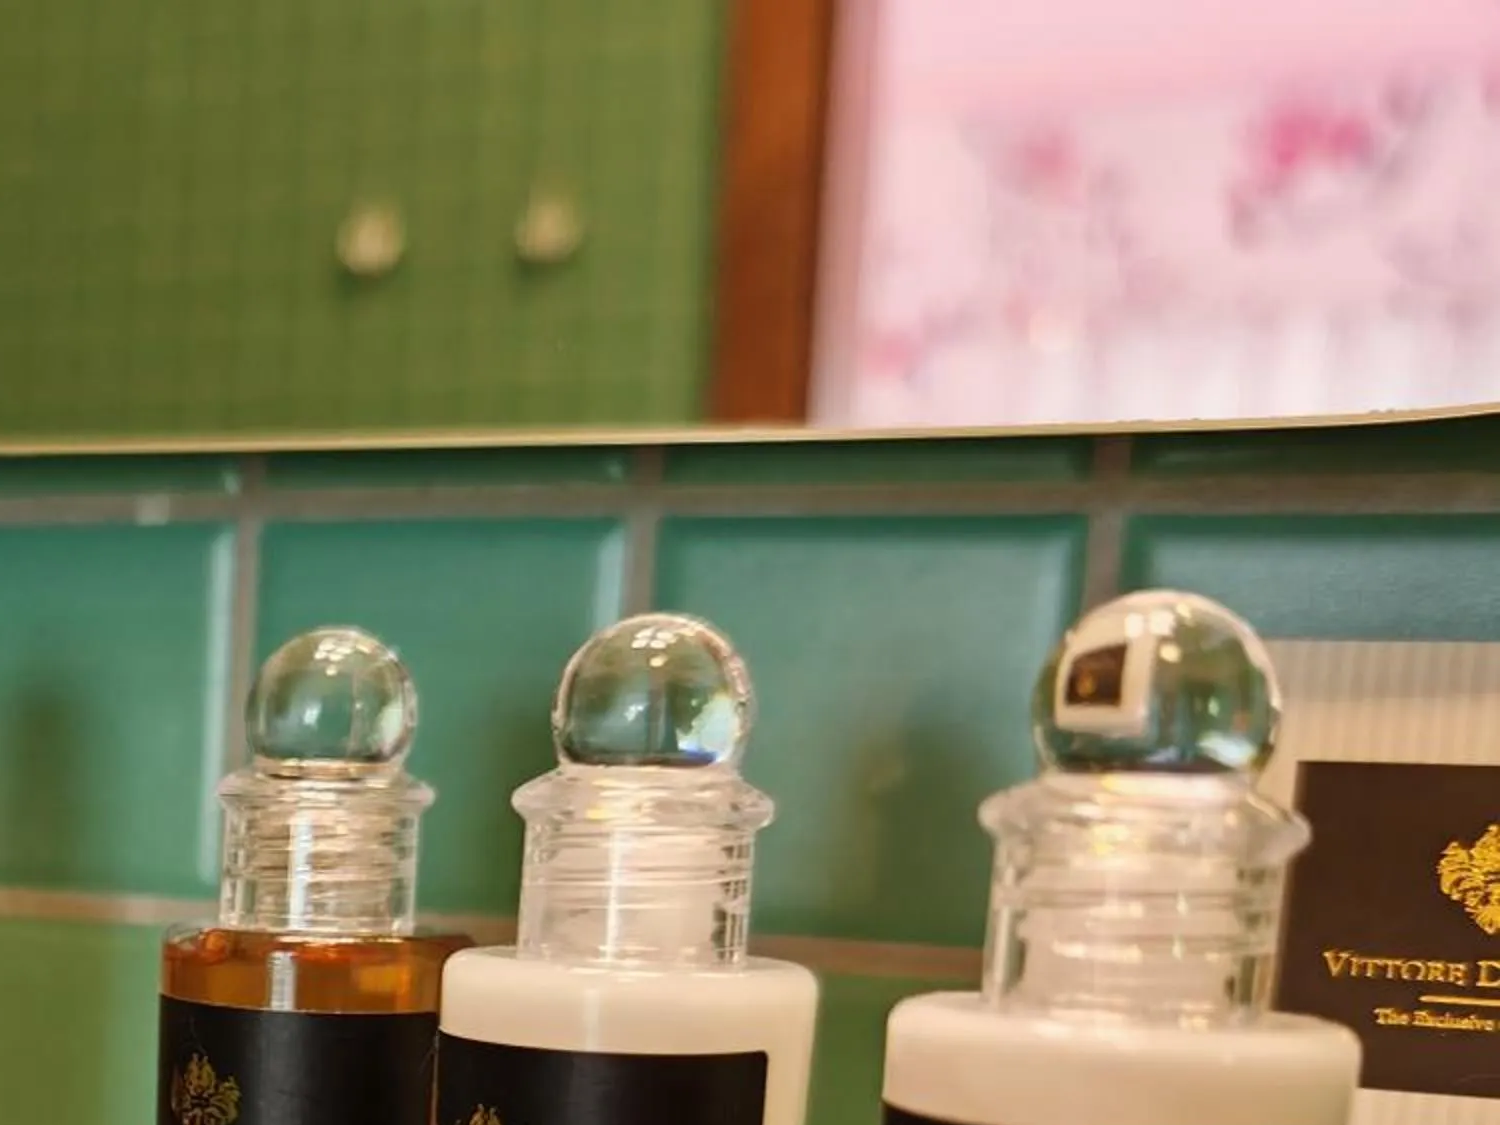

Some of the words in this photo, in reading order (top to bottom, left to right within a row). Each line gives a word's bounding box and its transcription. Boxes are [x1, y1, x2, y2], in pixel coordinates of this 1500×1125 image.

[1321, 951, 1467, 986] VITTORE
[1475, 960, 1500, 988] D
[1373, 1007, 1409, 1026] The
